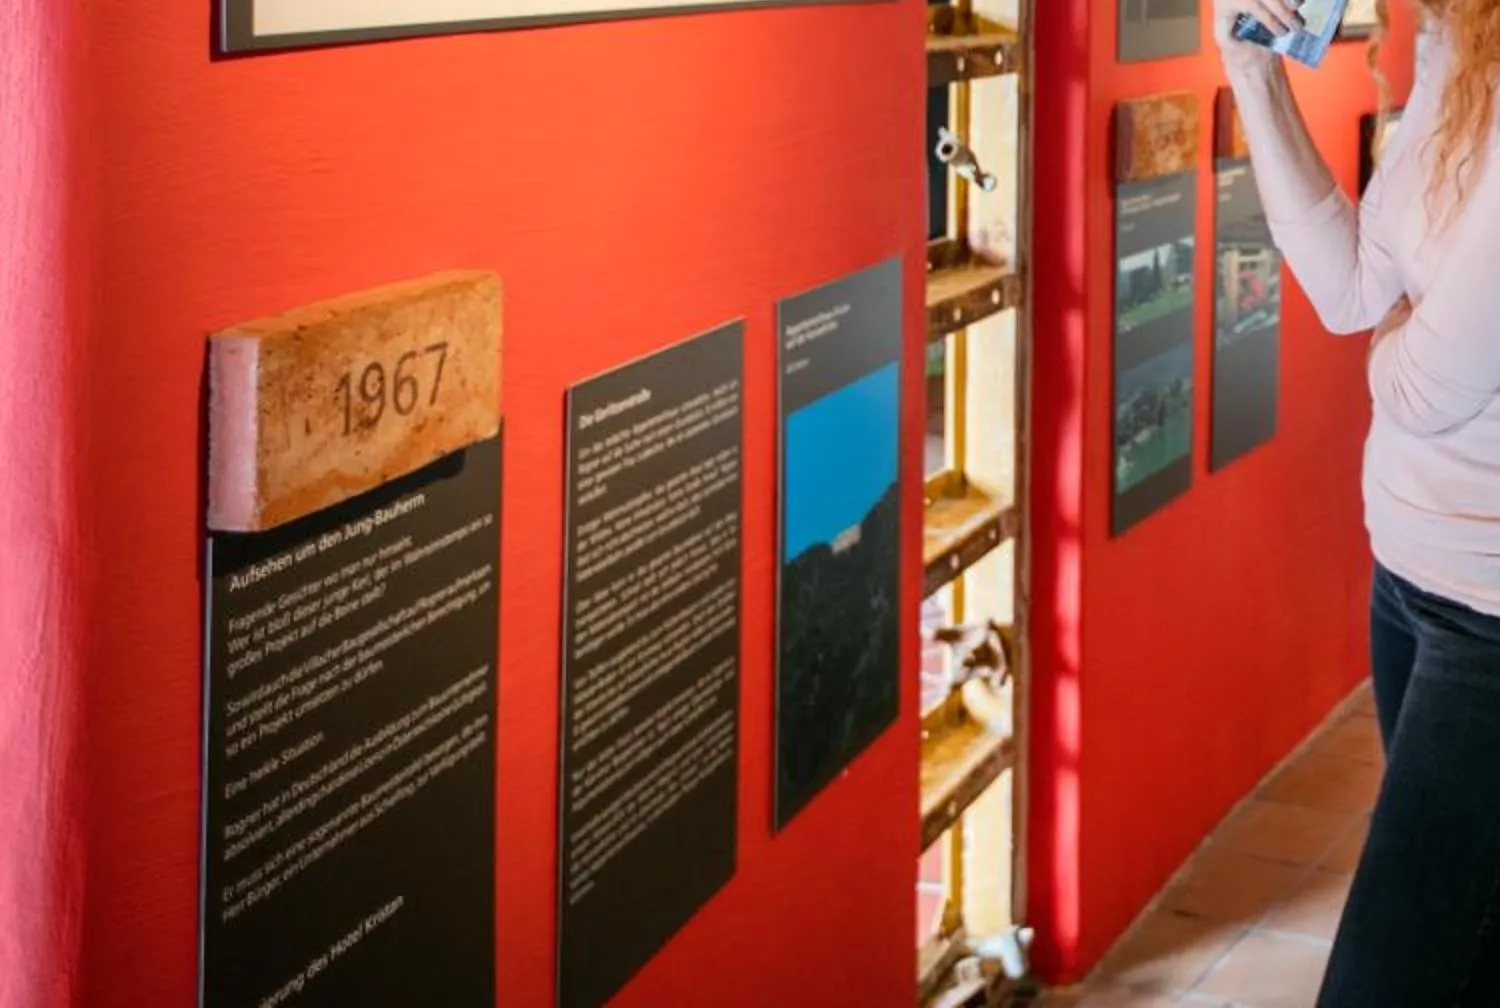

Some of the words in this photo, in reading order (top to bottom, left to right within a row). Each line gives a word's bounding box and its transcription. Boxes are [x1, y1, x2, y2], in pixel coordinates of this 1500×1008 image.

[336, 341, 449, 437] 1967
[229, 554, 292, 593] Aufsehen
[295, 543, 316, 564] um
[318, 530, 343, 553] den
